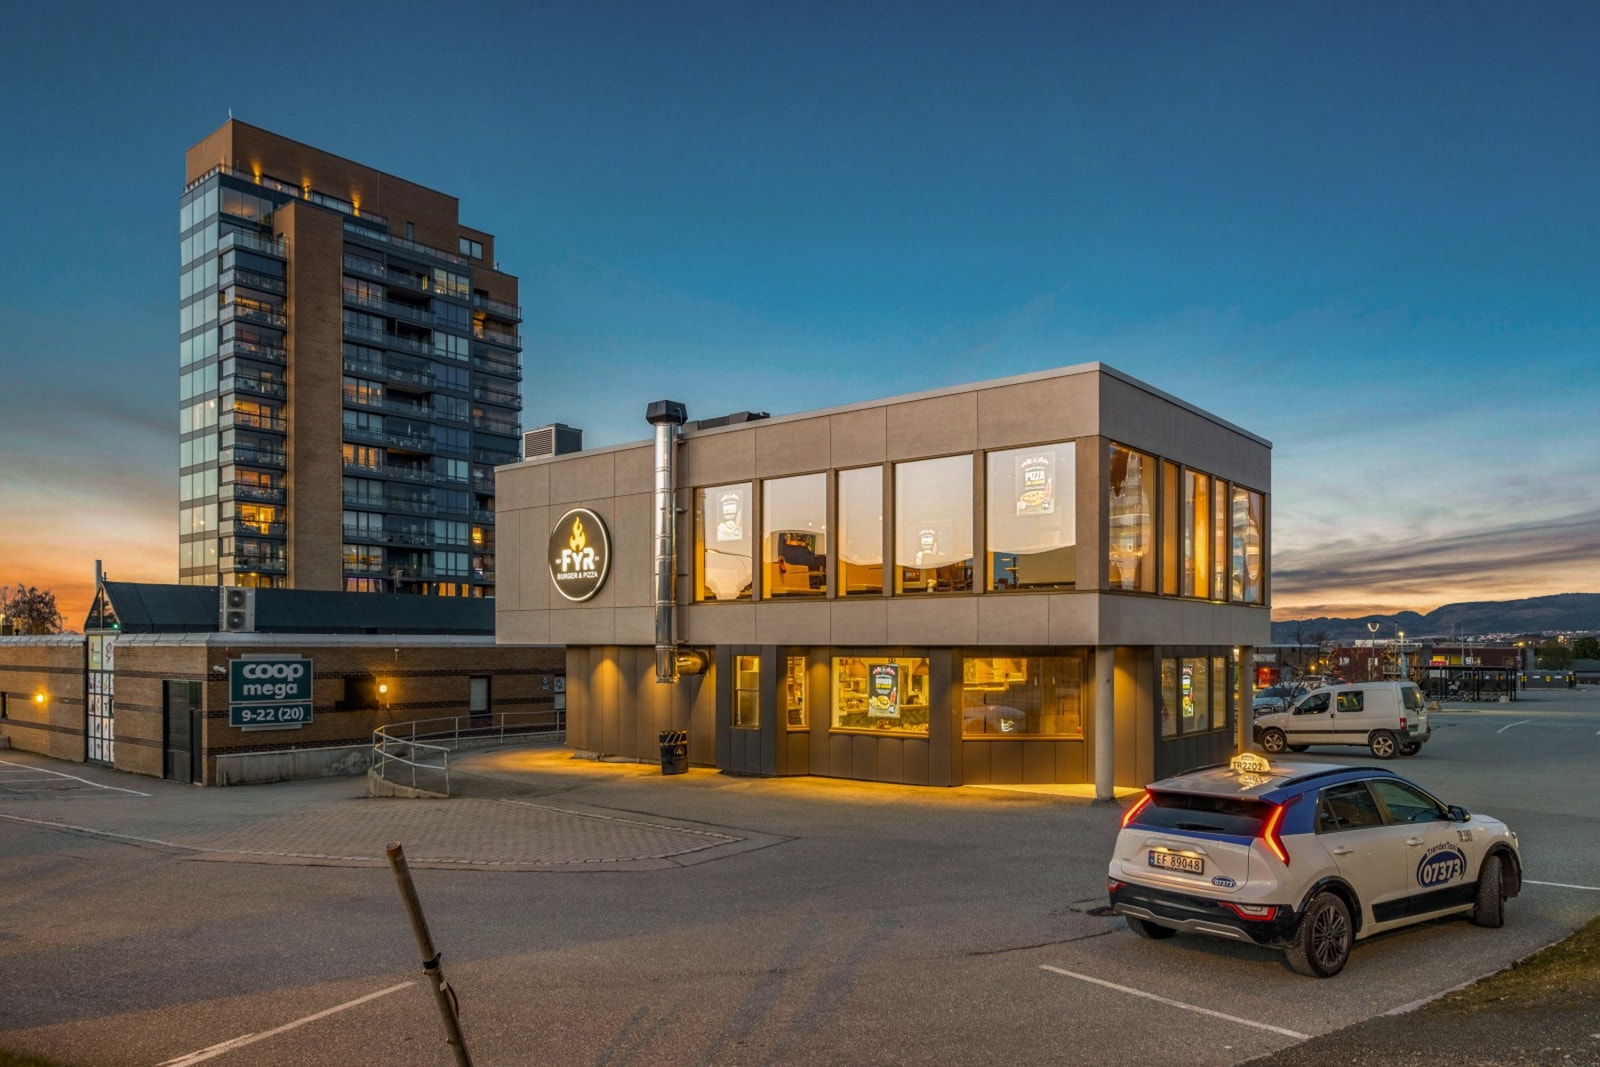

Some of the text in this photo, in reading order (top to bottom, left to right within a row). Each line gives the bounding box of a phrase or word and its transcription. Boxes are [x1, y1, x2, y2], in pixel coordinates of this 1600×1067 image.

[243, 664, 304, 682] coop
[243, 683, 298, 699] mega
[242, 706, 304, 721] 9-22 (20)
[1232, 761, 1262, 771] TR2202
[1156, 854, 1167, 865] EF
[1170, 856, 1200, 871] 89048
[1423, 858, 1461, 884] 07373
